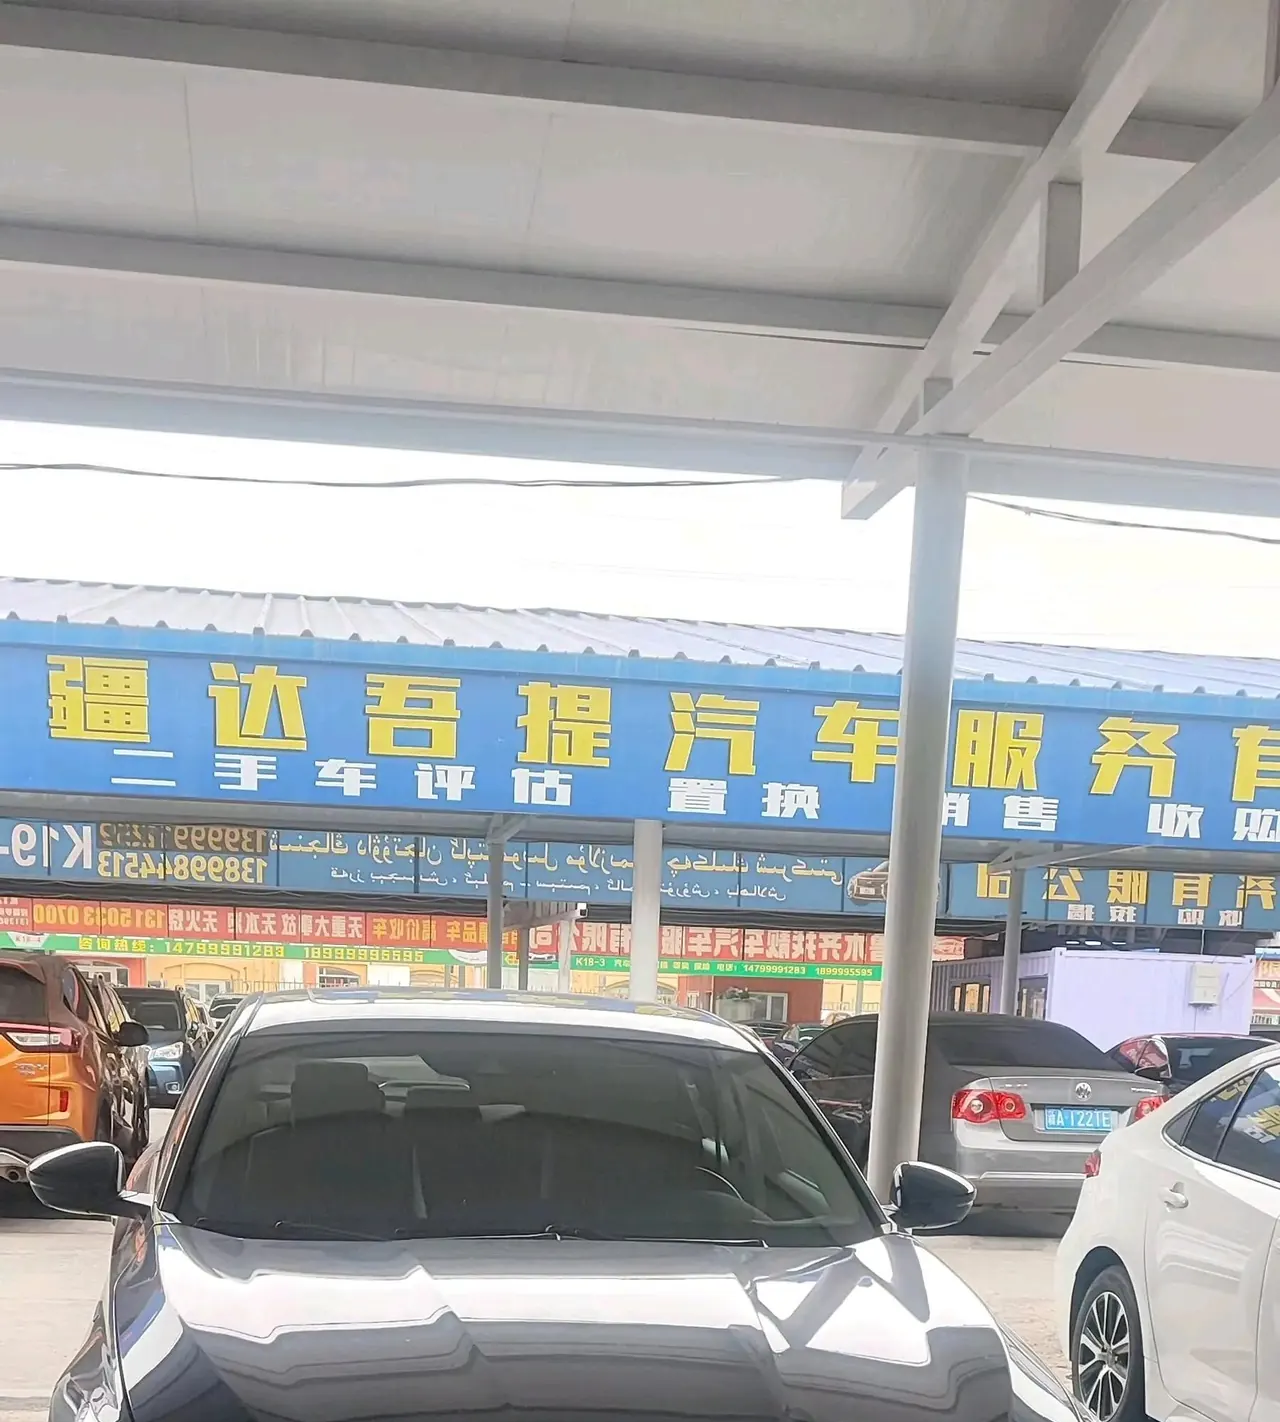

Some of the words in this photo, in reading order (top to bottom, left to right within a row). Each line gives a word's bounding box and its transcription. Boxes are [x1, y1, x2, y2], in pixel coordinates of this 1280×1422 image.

[111, 749, 573, 807] 二手车评估
[667, 778, 820, 820] 置换
